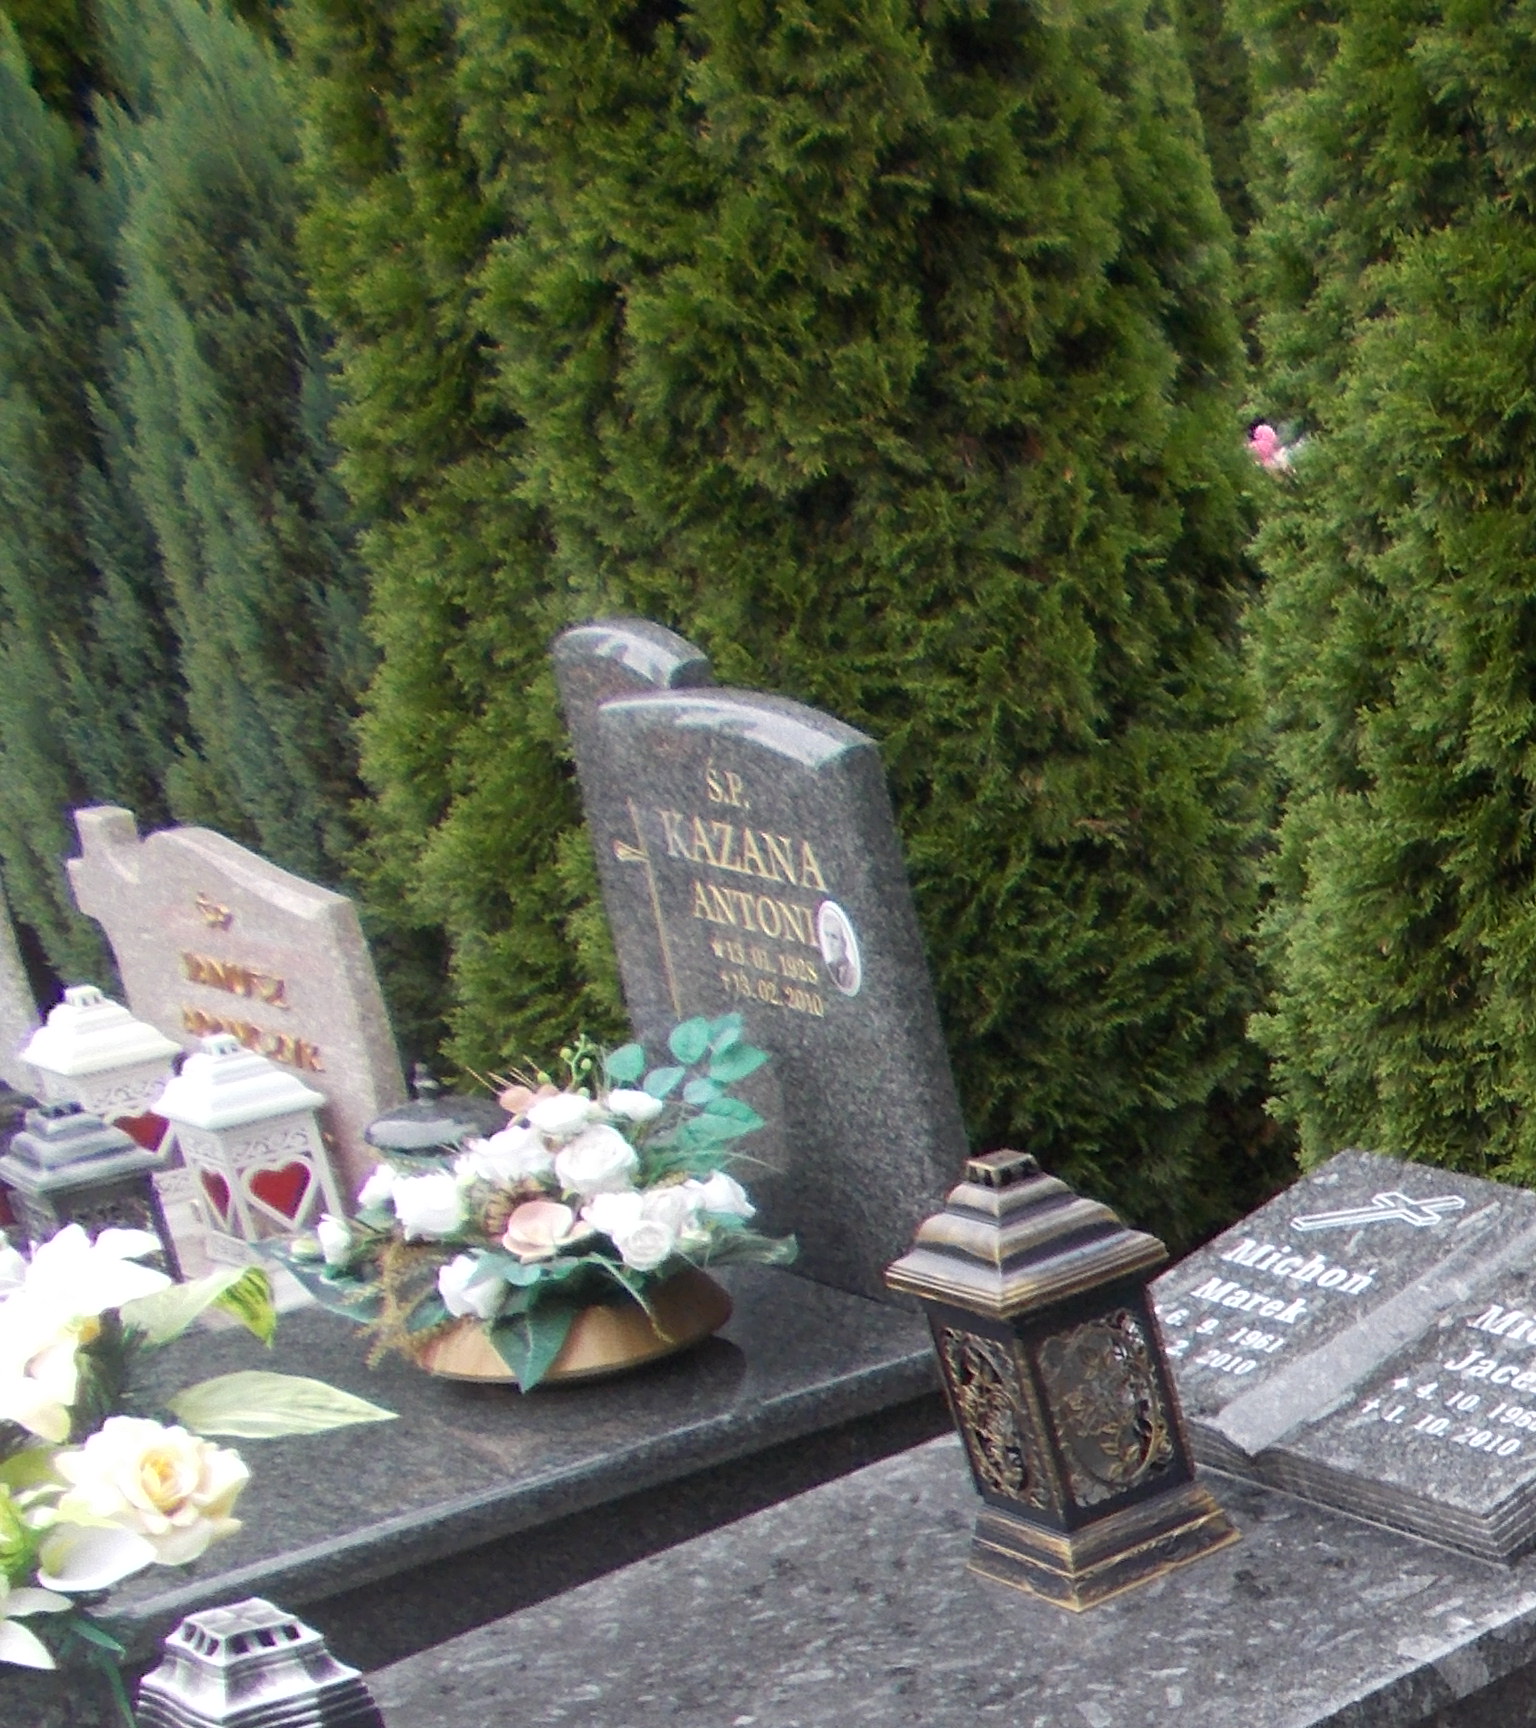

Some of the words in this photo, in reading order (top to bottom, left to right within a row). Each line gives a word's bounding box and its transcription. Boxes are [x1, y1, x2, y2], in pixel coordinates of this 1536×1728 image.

[658, 808, 829, 893] KAZANA
[692, 880, 821, 949] ANTONI
[1221, 1238, 1379, 1296] Michoń
[1190, 1276, 1310, 1326] Marek
[1194, 1349, 1258, 1376] 2010
[1227, 1326, 1285, 1354] 1961
[1450, 1426, 1522, 1457] 2010
